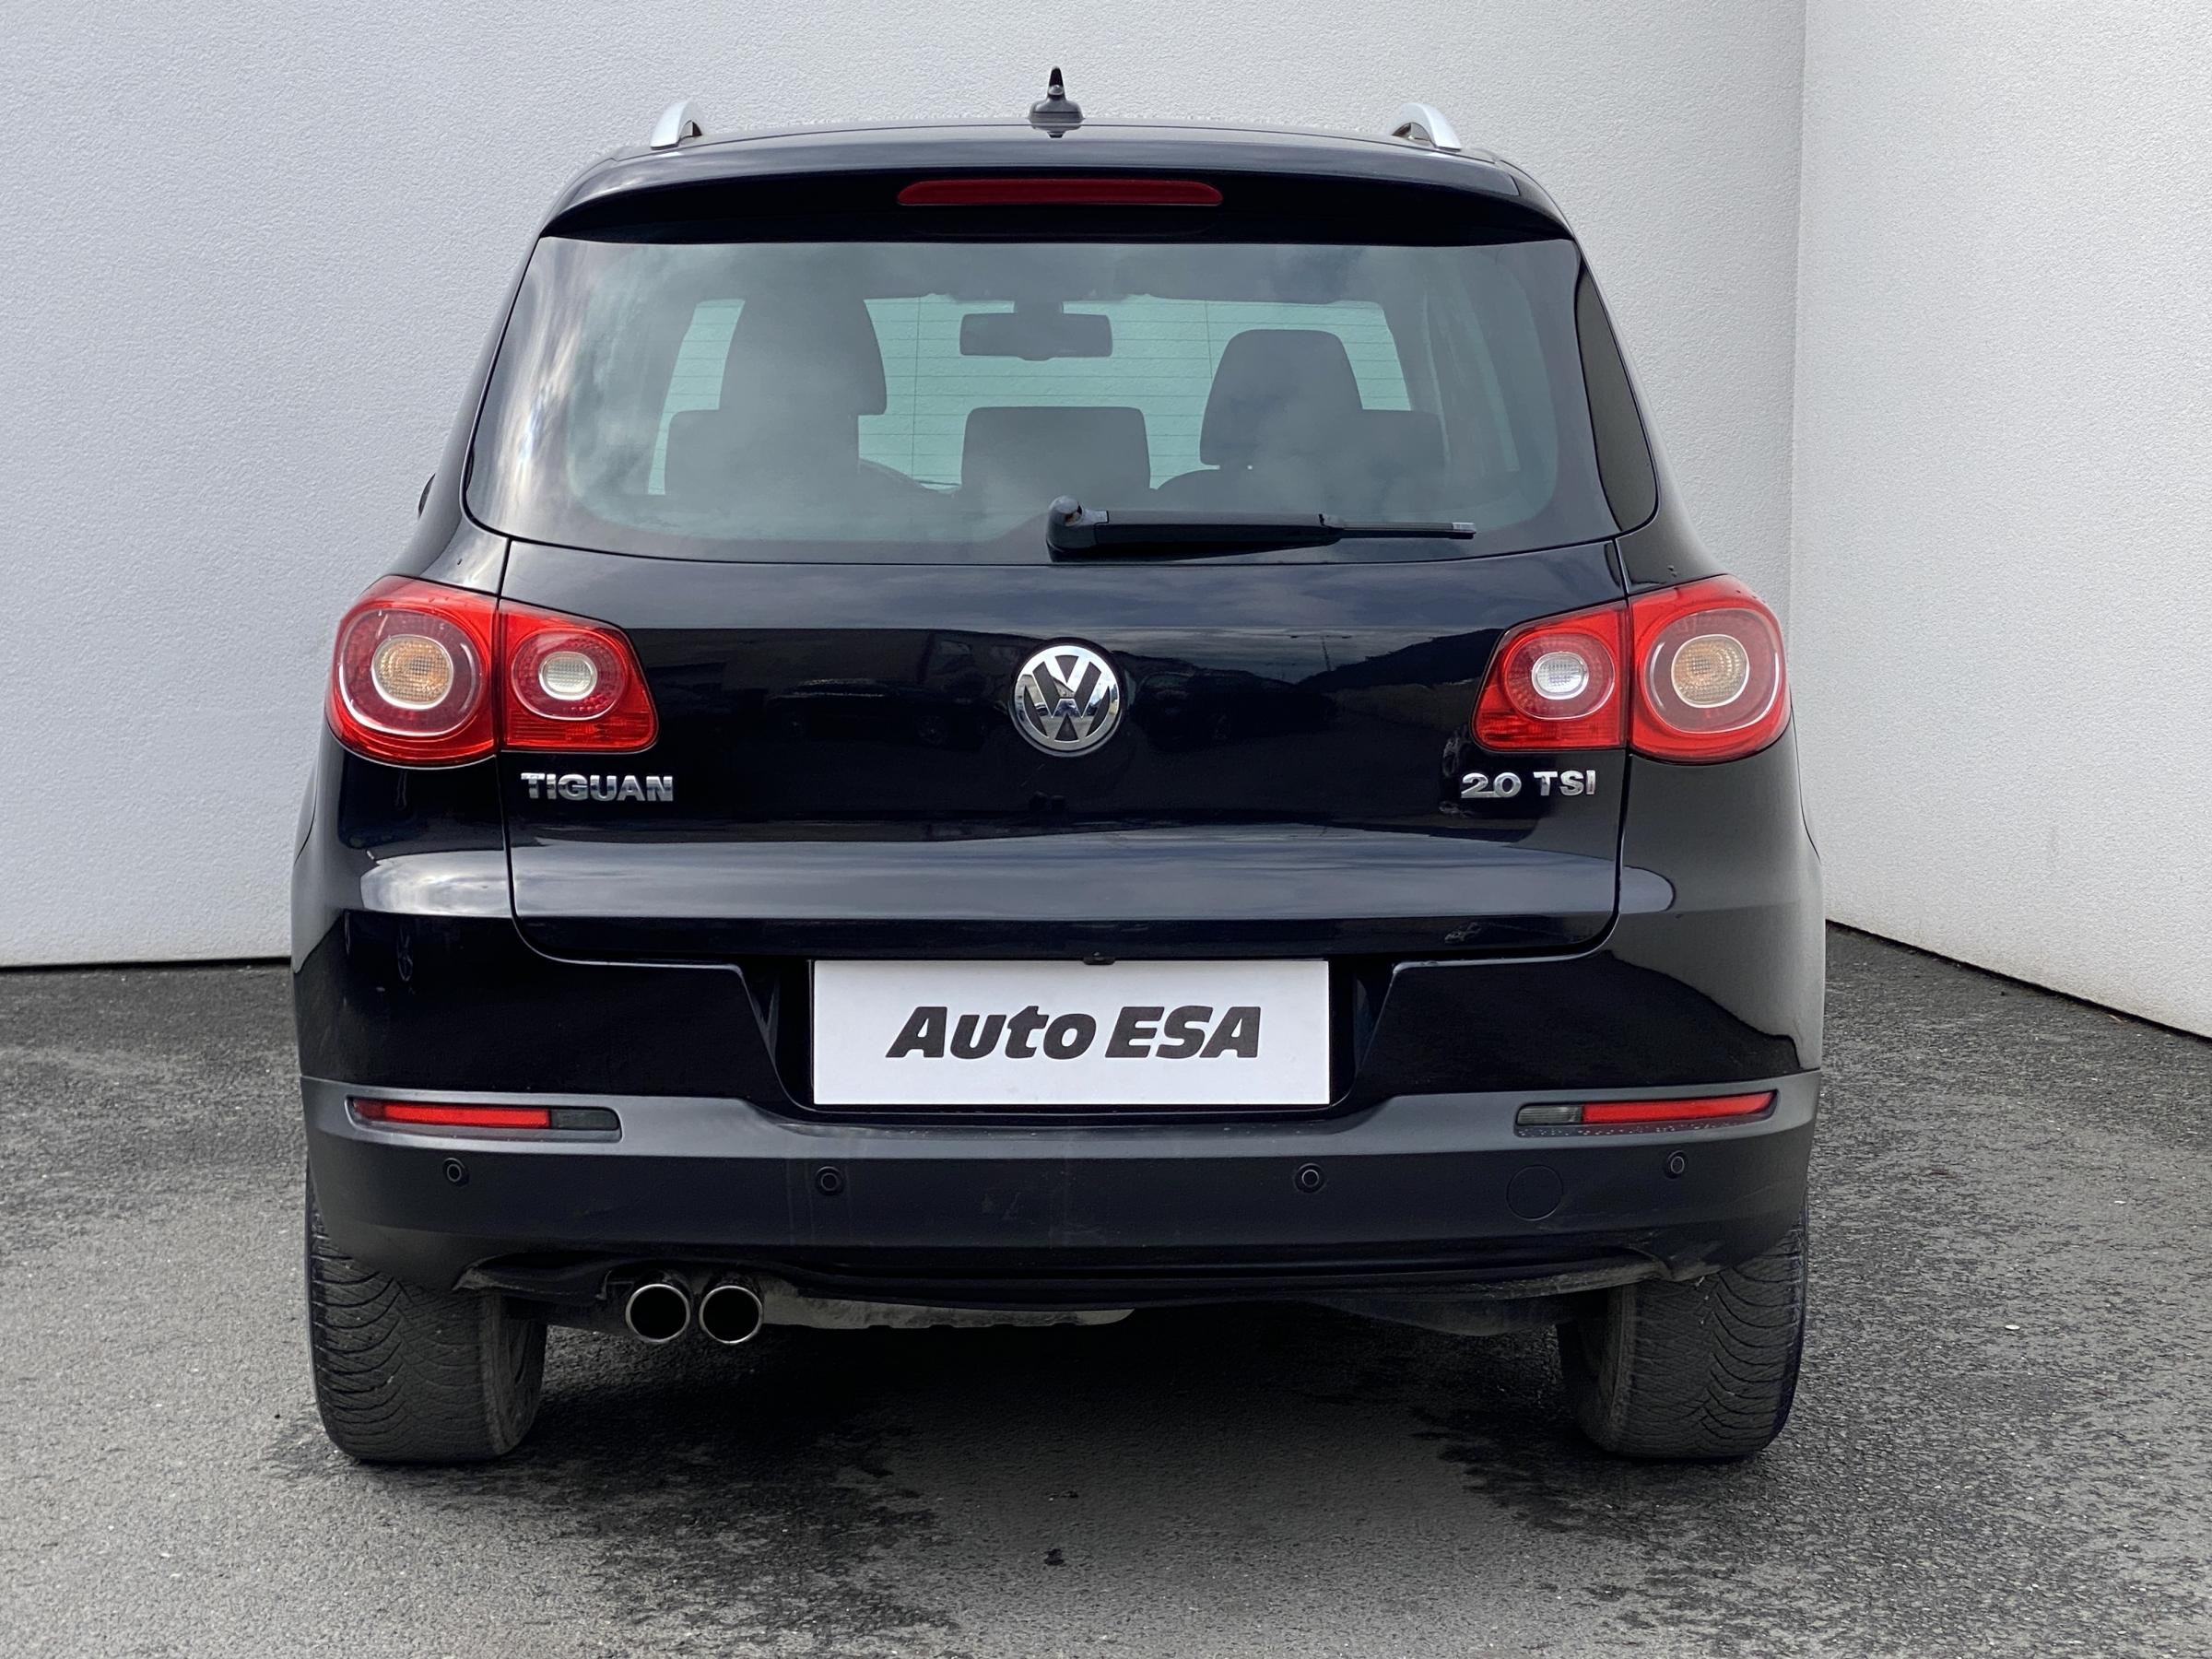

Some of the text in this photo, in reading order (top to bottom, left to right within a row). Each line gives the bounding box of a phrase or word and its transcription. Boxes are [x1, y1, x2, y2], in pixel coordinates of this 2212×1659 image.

[521, 772, 674, 802] TIGUAN
[1534, 770, 1596, 796] TSI
[886, 1006, 1261, 1059] Auto ESA
